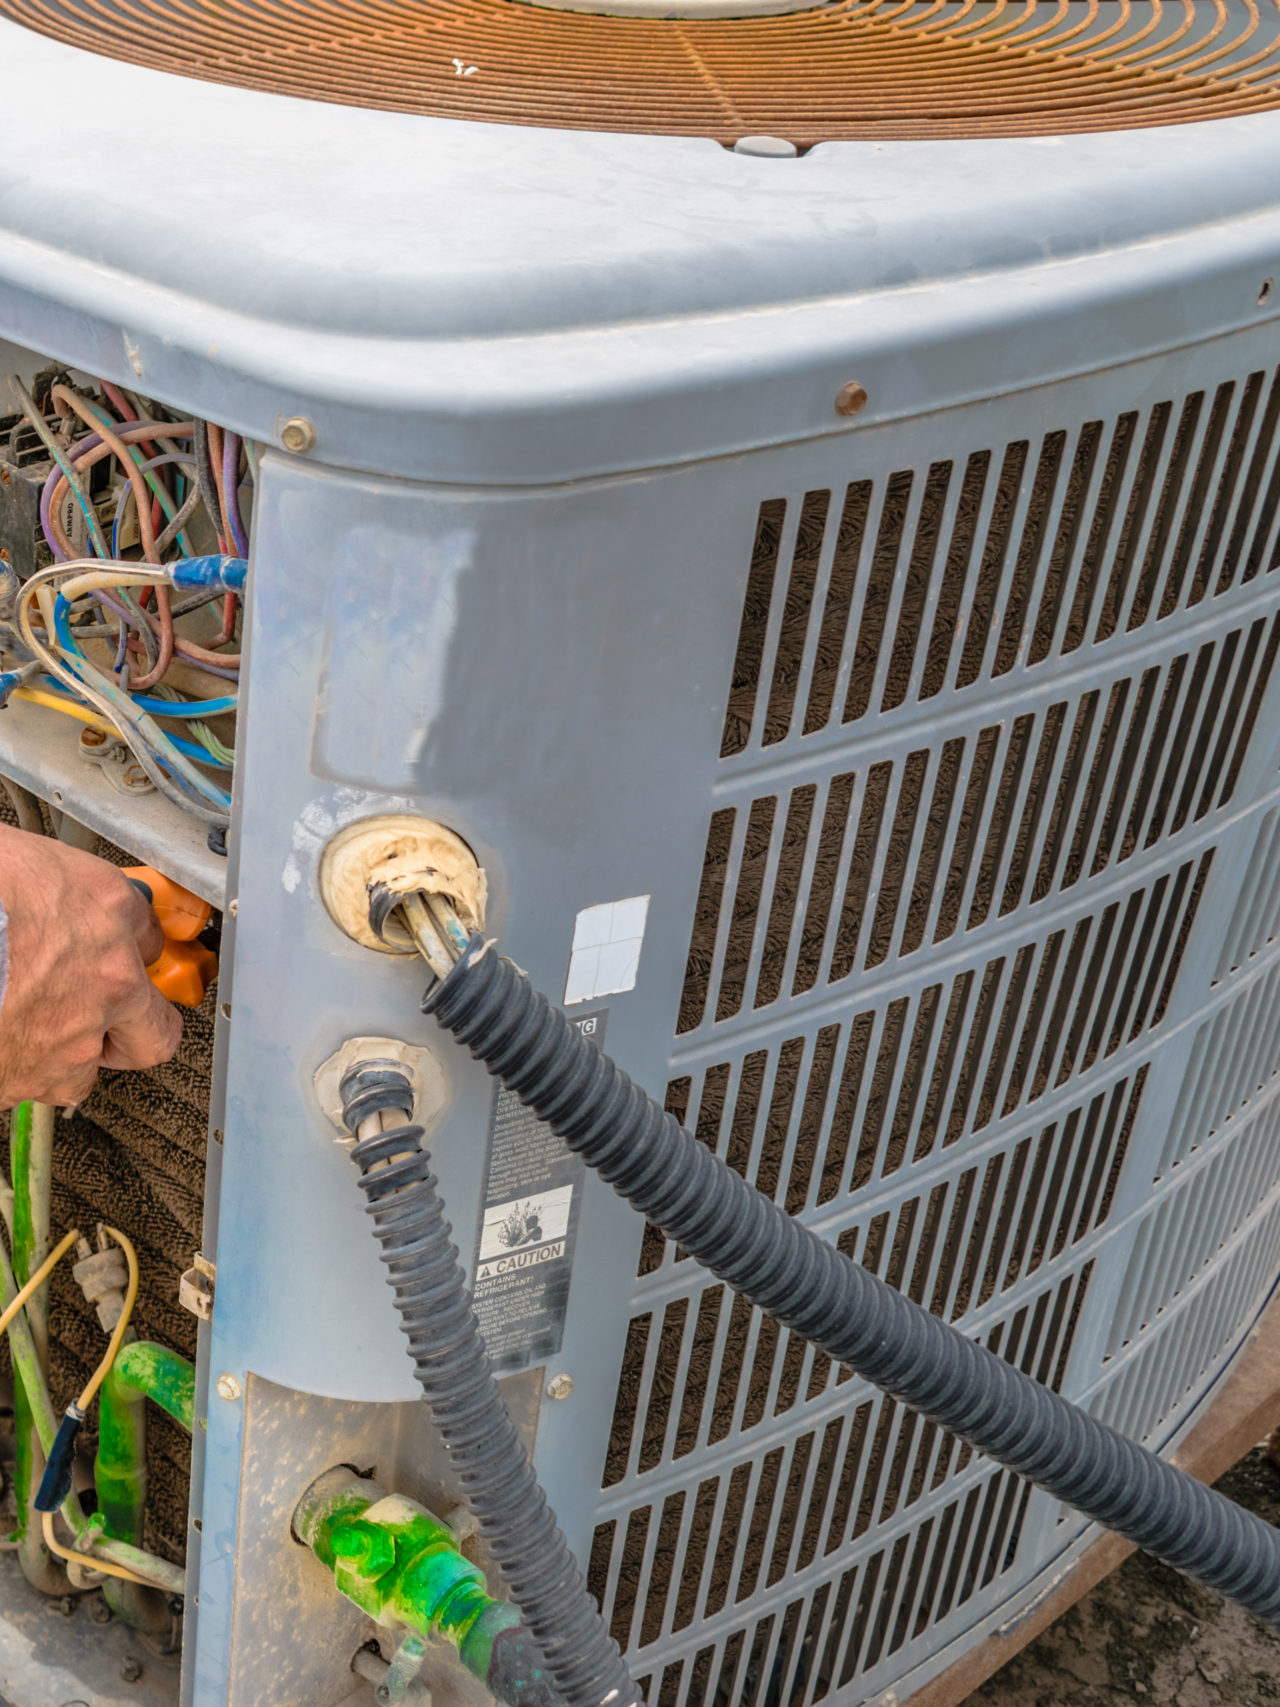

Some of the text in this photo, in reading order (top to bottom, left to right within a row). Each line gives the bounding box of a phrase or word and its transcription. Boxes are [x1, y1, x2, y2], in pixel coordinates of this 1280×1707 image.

[66, 502, 74, 537] ARMPRO
[497, 1244, 561, 1273] CAUTION
[474, 1276, 534, 1299] REFRIGERANT!
[475, 1273, 517, 1291] CONTAINS
